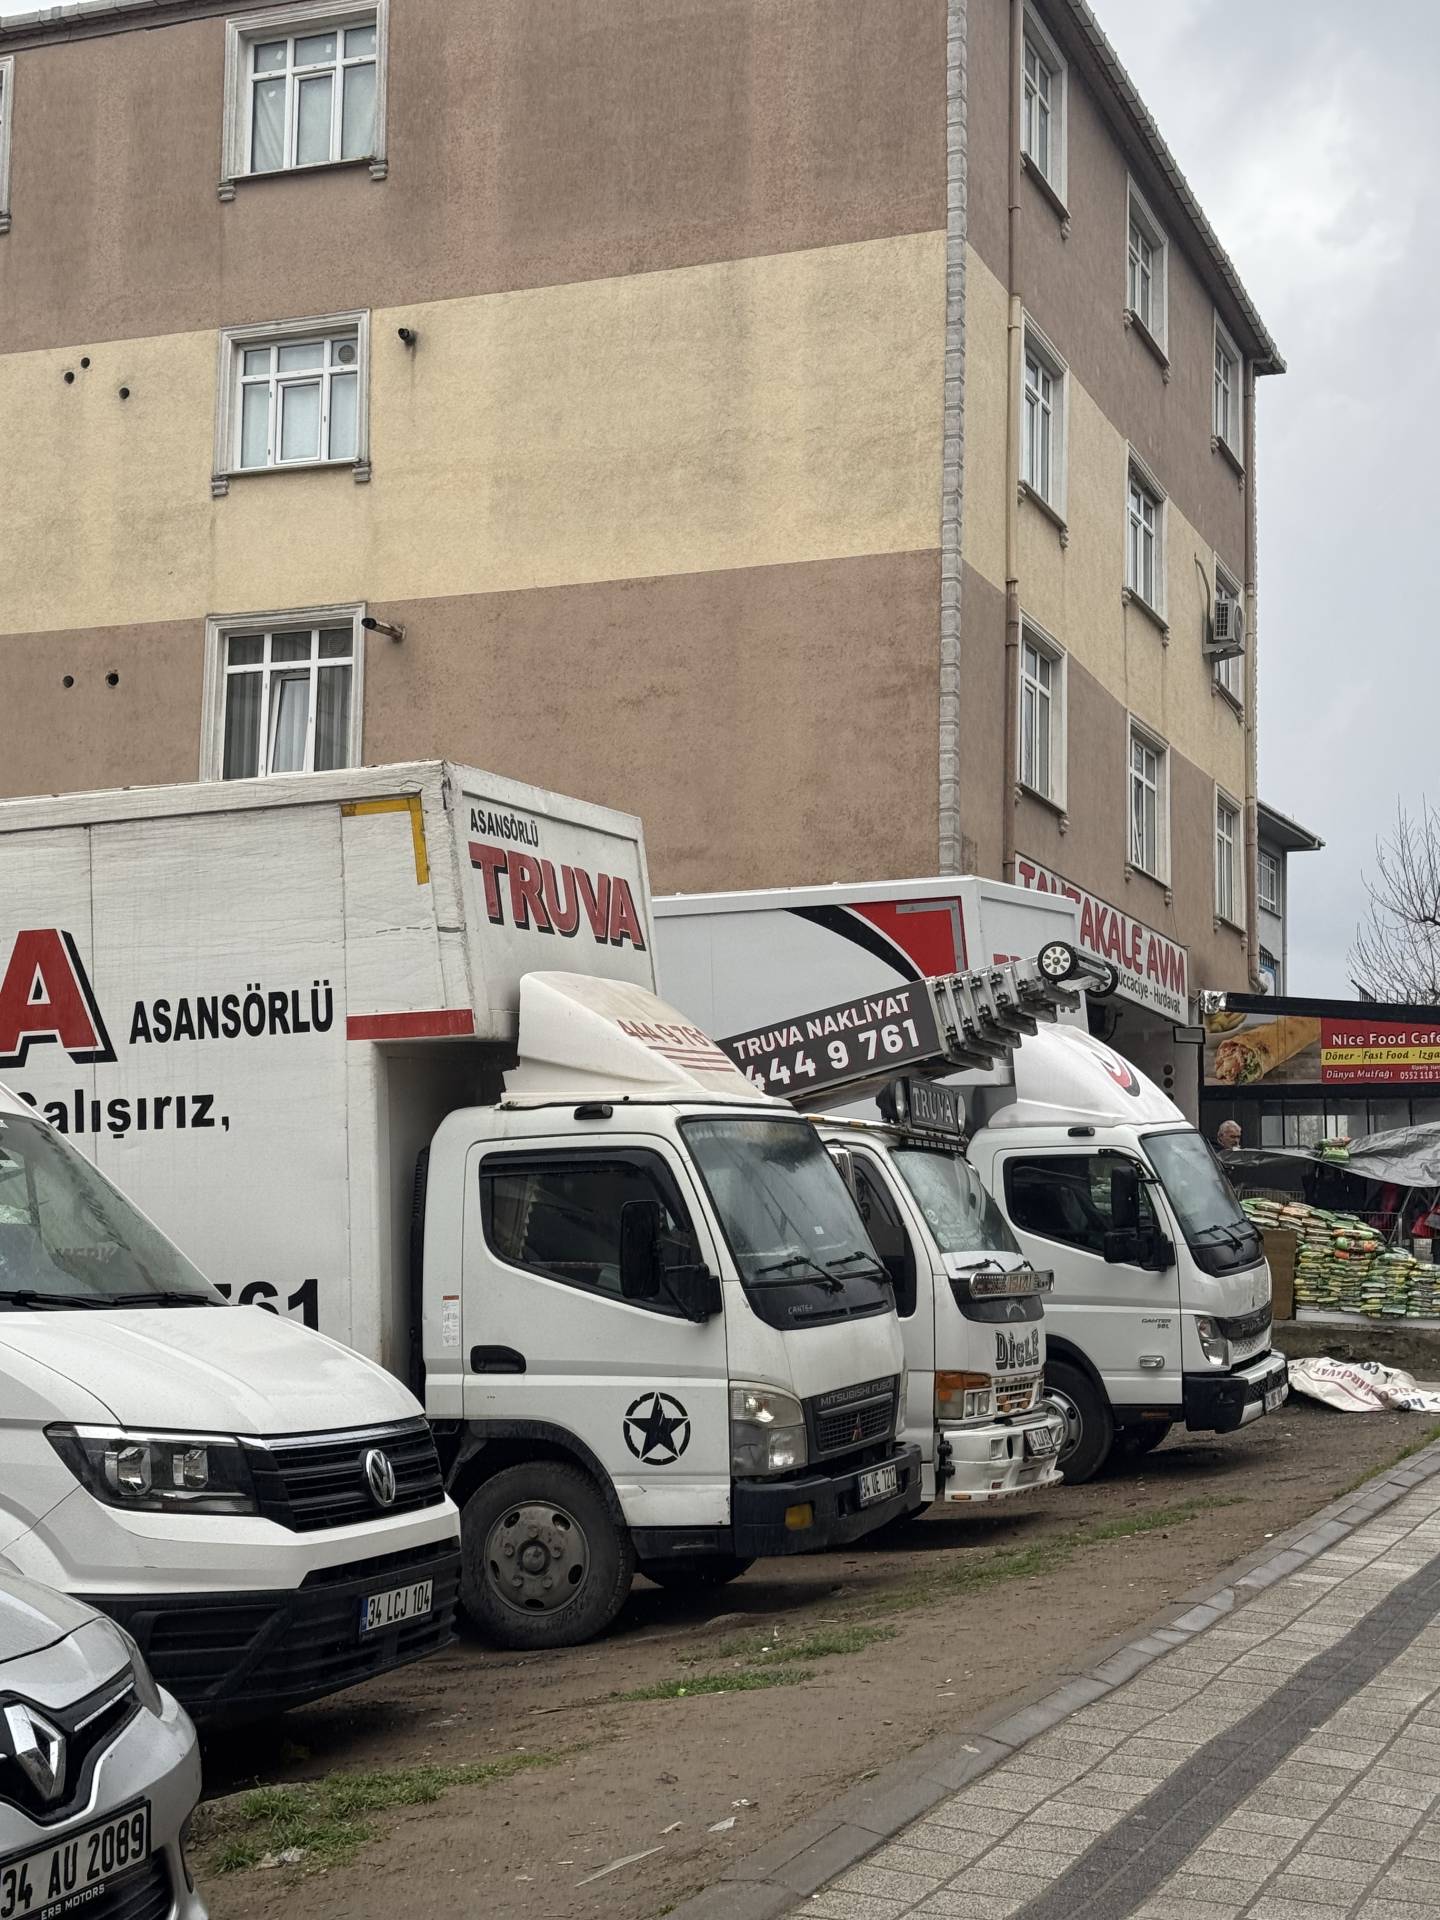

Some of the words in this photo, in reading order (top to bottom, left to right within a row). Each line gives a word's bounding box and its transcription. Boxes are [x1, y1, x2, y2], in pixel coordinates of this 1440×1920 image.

[470, 808, 539, 847] ASANSÖRLÜ
[468, 841, 647, 951] TRUVA
[1147, 935, 1186, 998] AVM
[129, 979, 334, 1045] ASANSÖRLÜ
[733, 1026, 804, 1060] TRUVA
[806, 992, 910, 1040] NAKLİYAT
[827, 1040, 849, 1070] 9
[858, 1019, 920, 1060] 761
[1325, 1051, 1355, 1061] Döner
[1363, 1051, 1384, 1060] Fast
[1386, 1050, 1409, 1059] Food
[1332, 1033, 1364, 1046] Nice
[1369, 1032, 1406, 1045] Food
[1326, 1070, 1355, 1080] Dünya
[913, 1087, 954, 1124] TRUVA
[213, 1279, 319, 1332] 61
[821, 1386, 870, 1406] MITSUBISHI
[368, 1597, 382, 1627] 34
[387, 1589, 408, 1621] LCJ
[413, 1583, 430, 1614] 104
[1, 1863, 33, 1918] 34
[48, 1842, 78, 1899] AU
[87, 1813, 144, 1881] 2089
[41, 1903, 62, 1920] ERS
[65, 1884, 105, 1910] MOTORS
